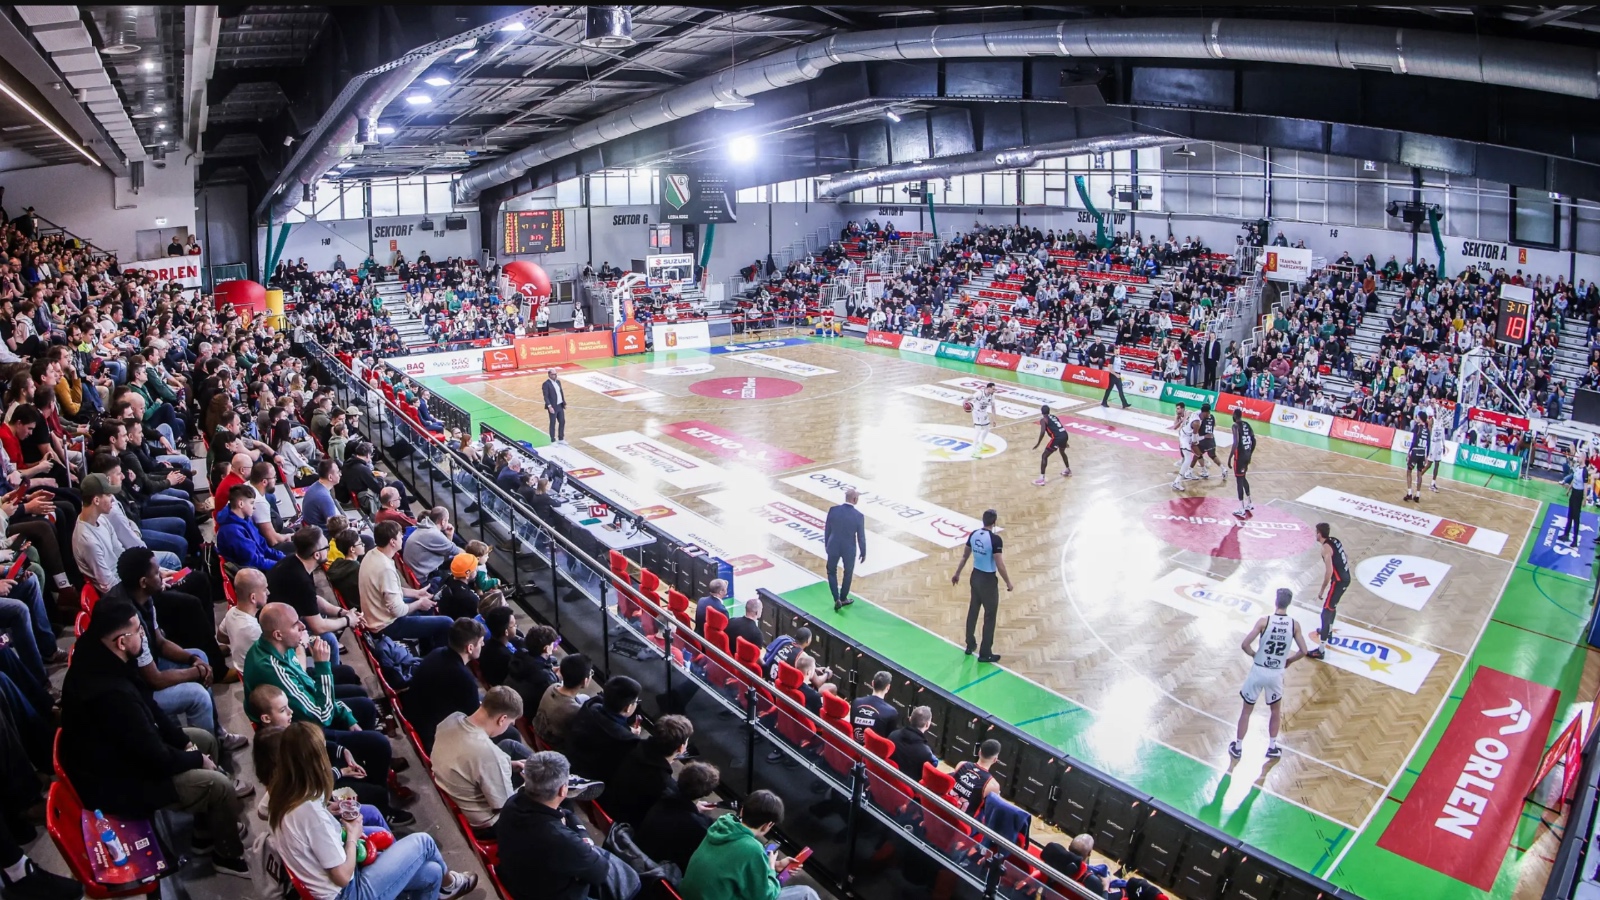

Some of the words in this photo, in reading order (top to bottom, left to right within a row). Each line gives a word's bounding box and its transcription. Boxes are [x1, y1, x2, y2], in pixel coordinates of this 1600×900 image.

[613, 214, 640, 226] SEKTOR
[643, 214, 648, 224] G
[878, 206, 898, 216] SEKTOR
[374, 225, 406, 238] SEKTOR
[408, 225, 414, 236] F
[1462, 241, 1499, 260] SEKTOR
[1500, 246, 1507, 261] A
[1520, 252, 1525, 260] A
[150, 265, 197, 281] ORLEN
[1478, 261, 1490, 271] 7-20
[1506, 301, 1527, 315] 3:17
[1506, 316, 1526, 339] 18
[680, 427, 743, 450] ORLEN
[1066, 422, 1140, 442] ORLEN
[1360, 433, 1379, 442] Paliwa
[867, 494, 924, 518] Bank
[1339, 496, 1431, 524] WARSZAWSKIE
[1152, 514, 1232, 528] Paliwa
[1355, 506, 1428, 528] TRAMWAJE
[786, 520, 825, 544] aliwa
[1369, 558, 1403, 588] SUZUKI
[1192, 590, 1252, 613] LOTTO
[1264, 641, 1286, 656] 32
[1327, 636, 1390, 661] LOTTO
[859, 708, 875, 716] PGE
[1434, 737, 1509, 839] ORLEN
